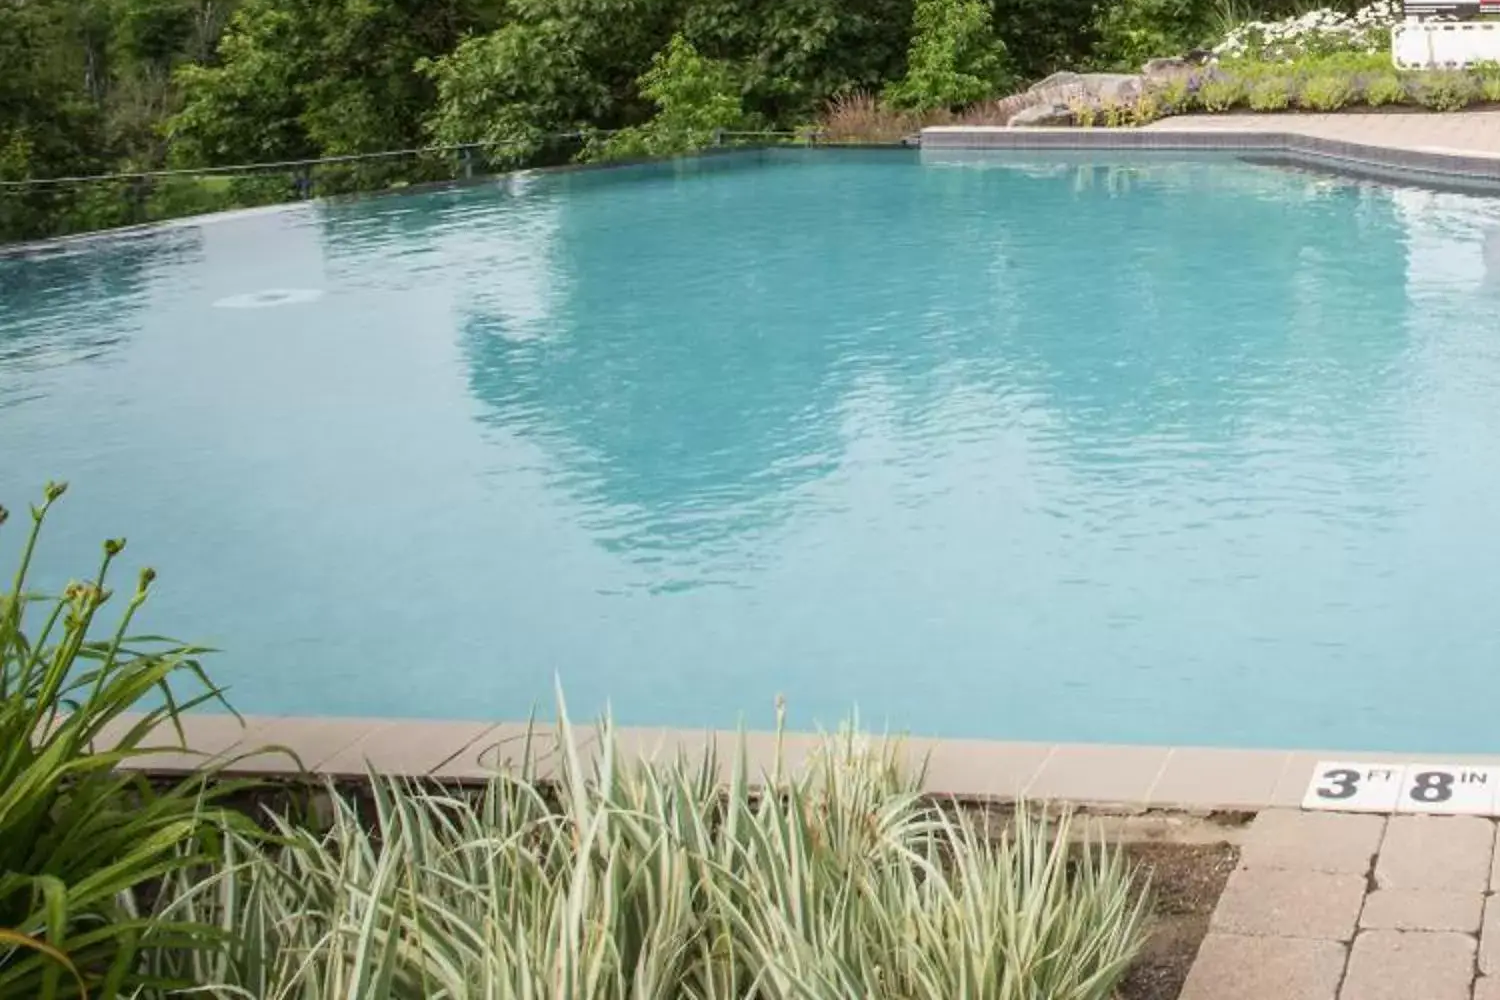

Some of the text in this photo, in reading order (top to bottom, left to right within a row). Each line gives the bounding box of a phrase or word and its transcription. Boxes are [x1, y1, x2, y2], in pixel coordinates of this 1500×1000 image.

[1317, 769, 1361, 799] 3
[1410, 771, 1454, 802] 8
[1461, 773, 1488, 784] IN
